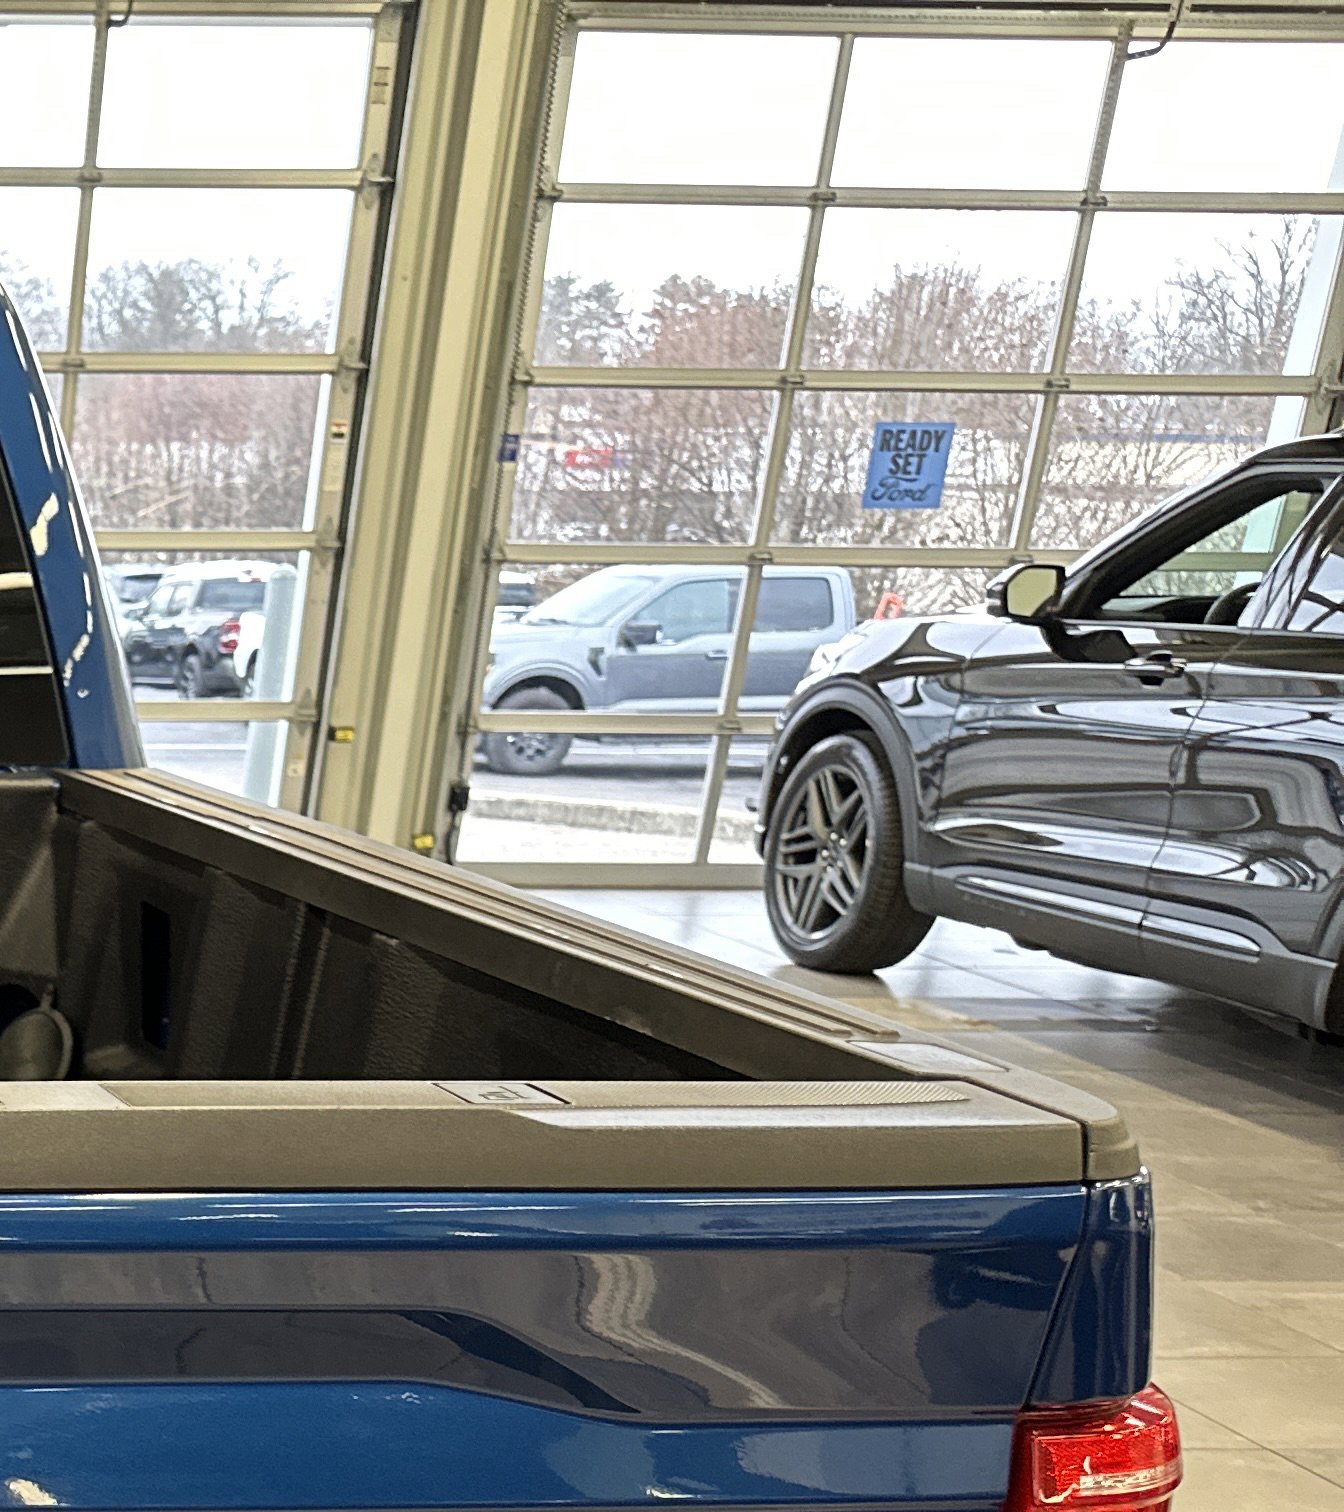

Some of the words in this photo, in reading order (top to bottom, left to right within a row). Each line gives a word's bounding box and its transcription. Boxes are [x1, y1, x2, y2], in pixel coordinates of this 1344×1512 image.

[879, 429, 947, 452] READY
[888, 453, 927, 475] SET
[871, 476, 936, 501] Ford
